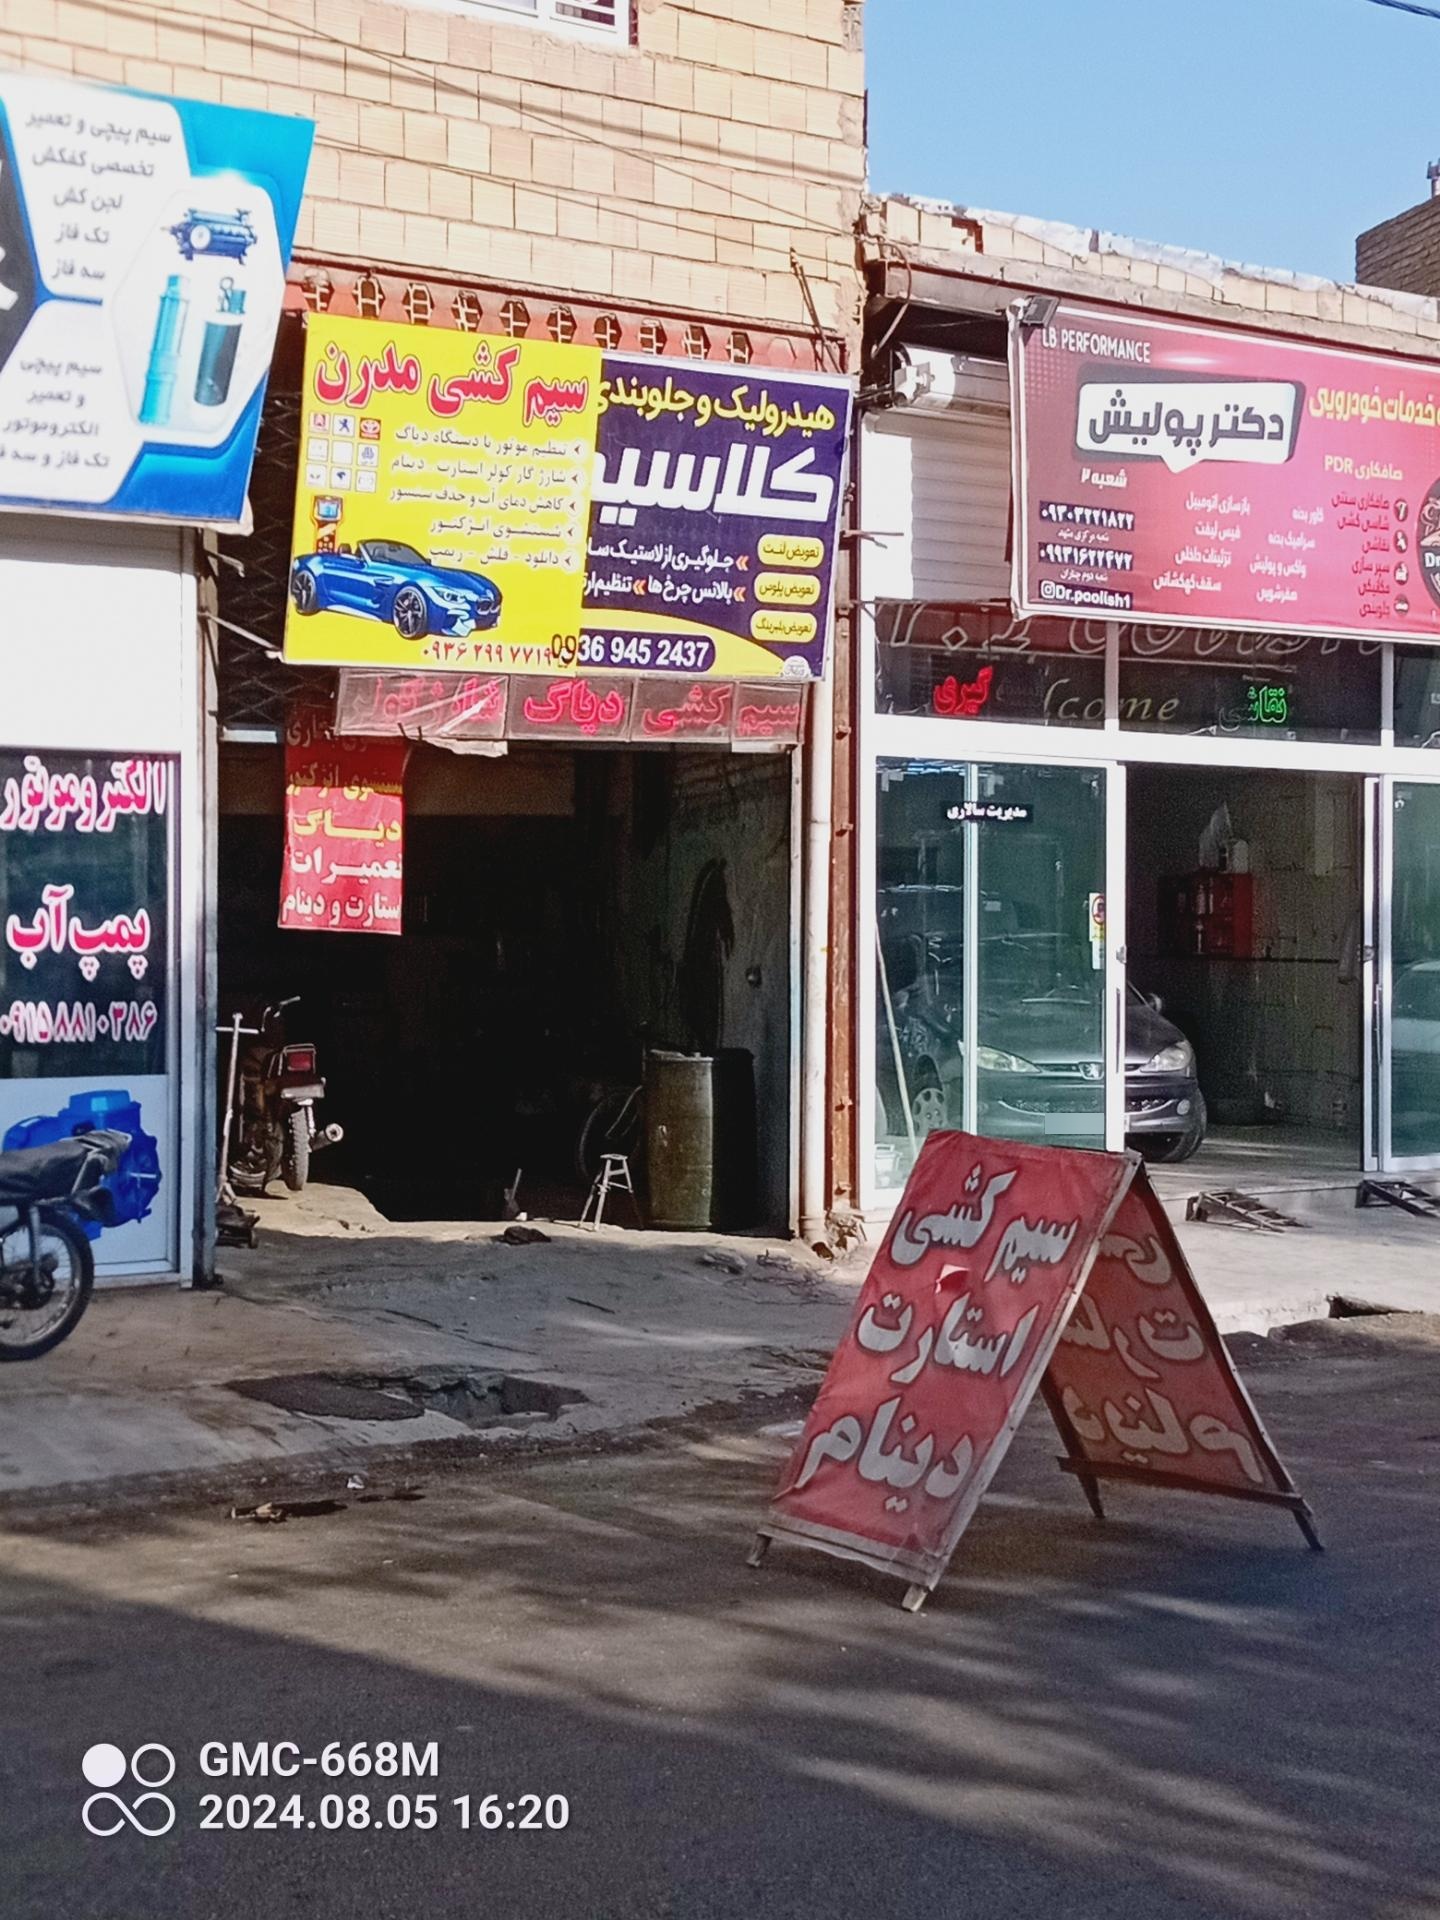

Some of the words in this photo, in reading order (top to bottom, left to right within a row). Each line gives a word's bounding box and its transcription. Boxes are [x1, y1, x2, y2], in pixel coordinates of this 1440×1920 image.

[24, 112, 73, 129] تعمیر
[75, 118, 86, 134] و
[89, 122, 132, 145] پیچی
[134, 127, 174, 146] سیم
[52, 185, 88, 207] کش
[90, 193, 124, 213] لجن
[53, 222, 80, 244] فاز
[83, 226, 111, 244] تک
[50, 256, 76, 281] فاز
[79, 264, 106, 281] سه
[1061, 329, 1151, 363] PERFORMANCE
[65, 361, 104, 378] سیم
[315, 340, 422, 409] مدرن
[427, 340, 521, 419] کشی
[25, 390, 73, 405] تعمیر
[75, 393, 86, 409] و
[523, 376, 589, 428] سیم
[598, 376, 694, 421] جلوبندی
[1308, 385, 1383, 424] خودرویی
[1384, 390, 1436, 427] خدمات
[695, 393, 711, 427] و
[713, 384, 835, 437] هیدرولیک
[1088, 389, 1203, 455] پولیش
[1209, 403, 1285, 446] دکتر
[10, 449, 38, 462] سه
[40, 452, 51, 468] و
[54, 449, 80, 470] فاز
[83, 451, 112, 468] تک
[1324, 455, 1353, 474] PDR
[1091, 468, 1128, 490] شعبه
[1354, 461, 1404, 480] صافکاری
[611, 539, 663, 564] لاستیک
[763, 542, 786, 555] لنت
[786, 545, 819, 561] تعویض
[671, 549, 734, 573] جلوگیری
[594, 572, 632, 597] تنظیم
[648, 576, 663, 594] ها
[662, 573, 692, 603] چرخ
[692, 581, 733, 604] بالانس
[759, 581, 783, 597] پلوس
[784, 584, 815, 598] تعویض
[611, 636, 651, 665] 945
[655, 639, 709, 667] 2437
[524, 680, 624, 735] دیاگ
[642, 685, 731, 736] کشی
[738, 702, 799, 735] سیم
[947, 802, 985, 819] سالاری
[986, 805, 1027, 821] مدیریت
[293, 808, 401, 847] دیاگ
[282, 886, 325, 922] دینام
[328, 900, 341, 926] و
[6, 884, 74, 970] آب
[68, 907, 151, 982] پمپ
[890, 1162, 1017, 1266] کشی
[985, 1215, 1079, 1284] سیم
[857, 1291, 1039, 1384] استارت
[797, 1396, 974, 1511] دینام
